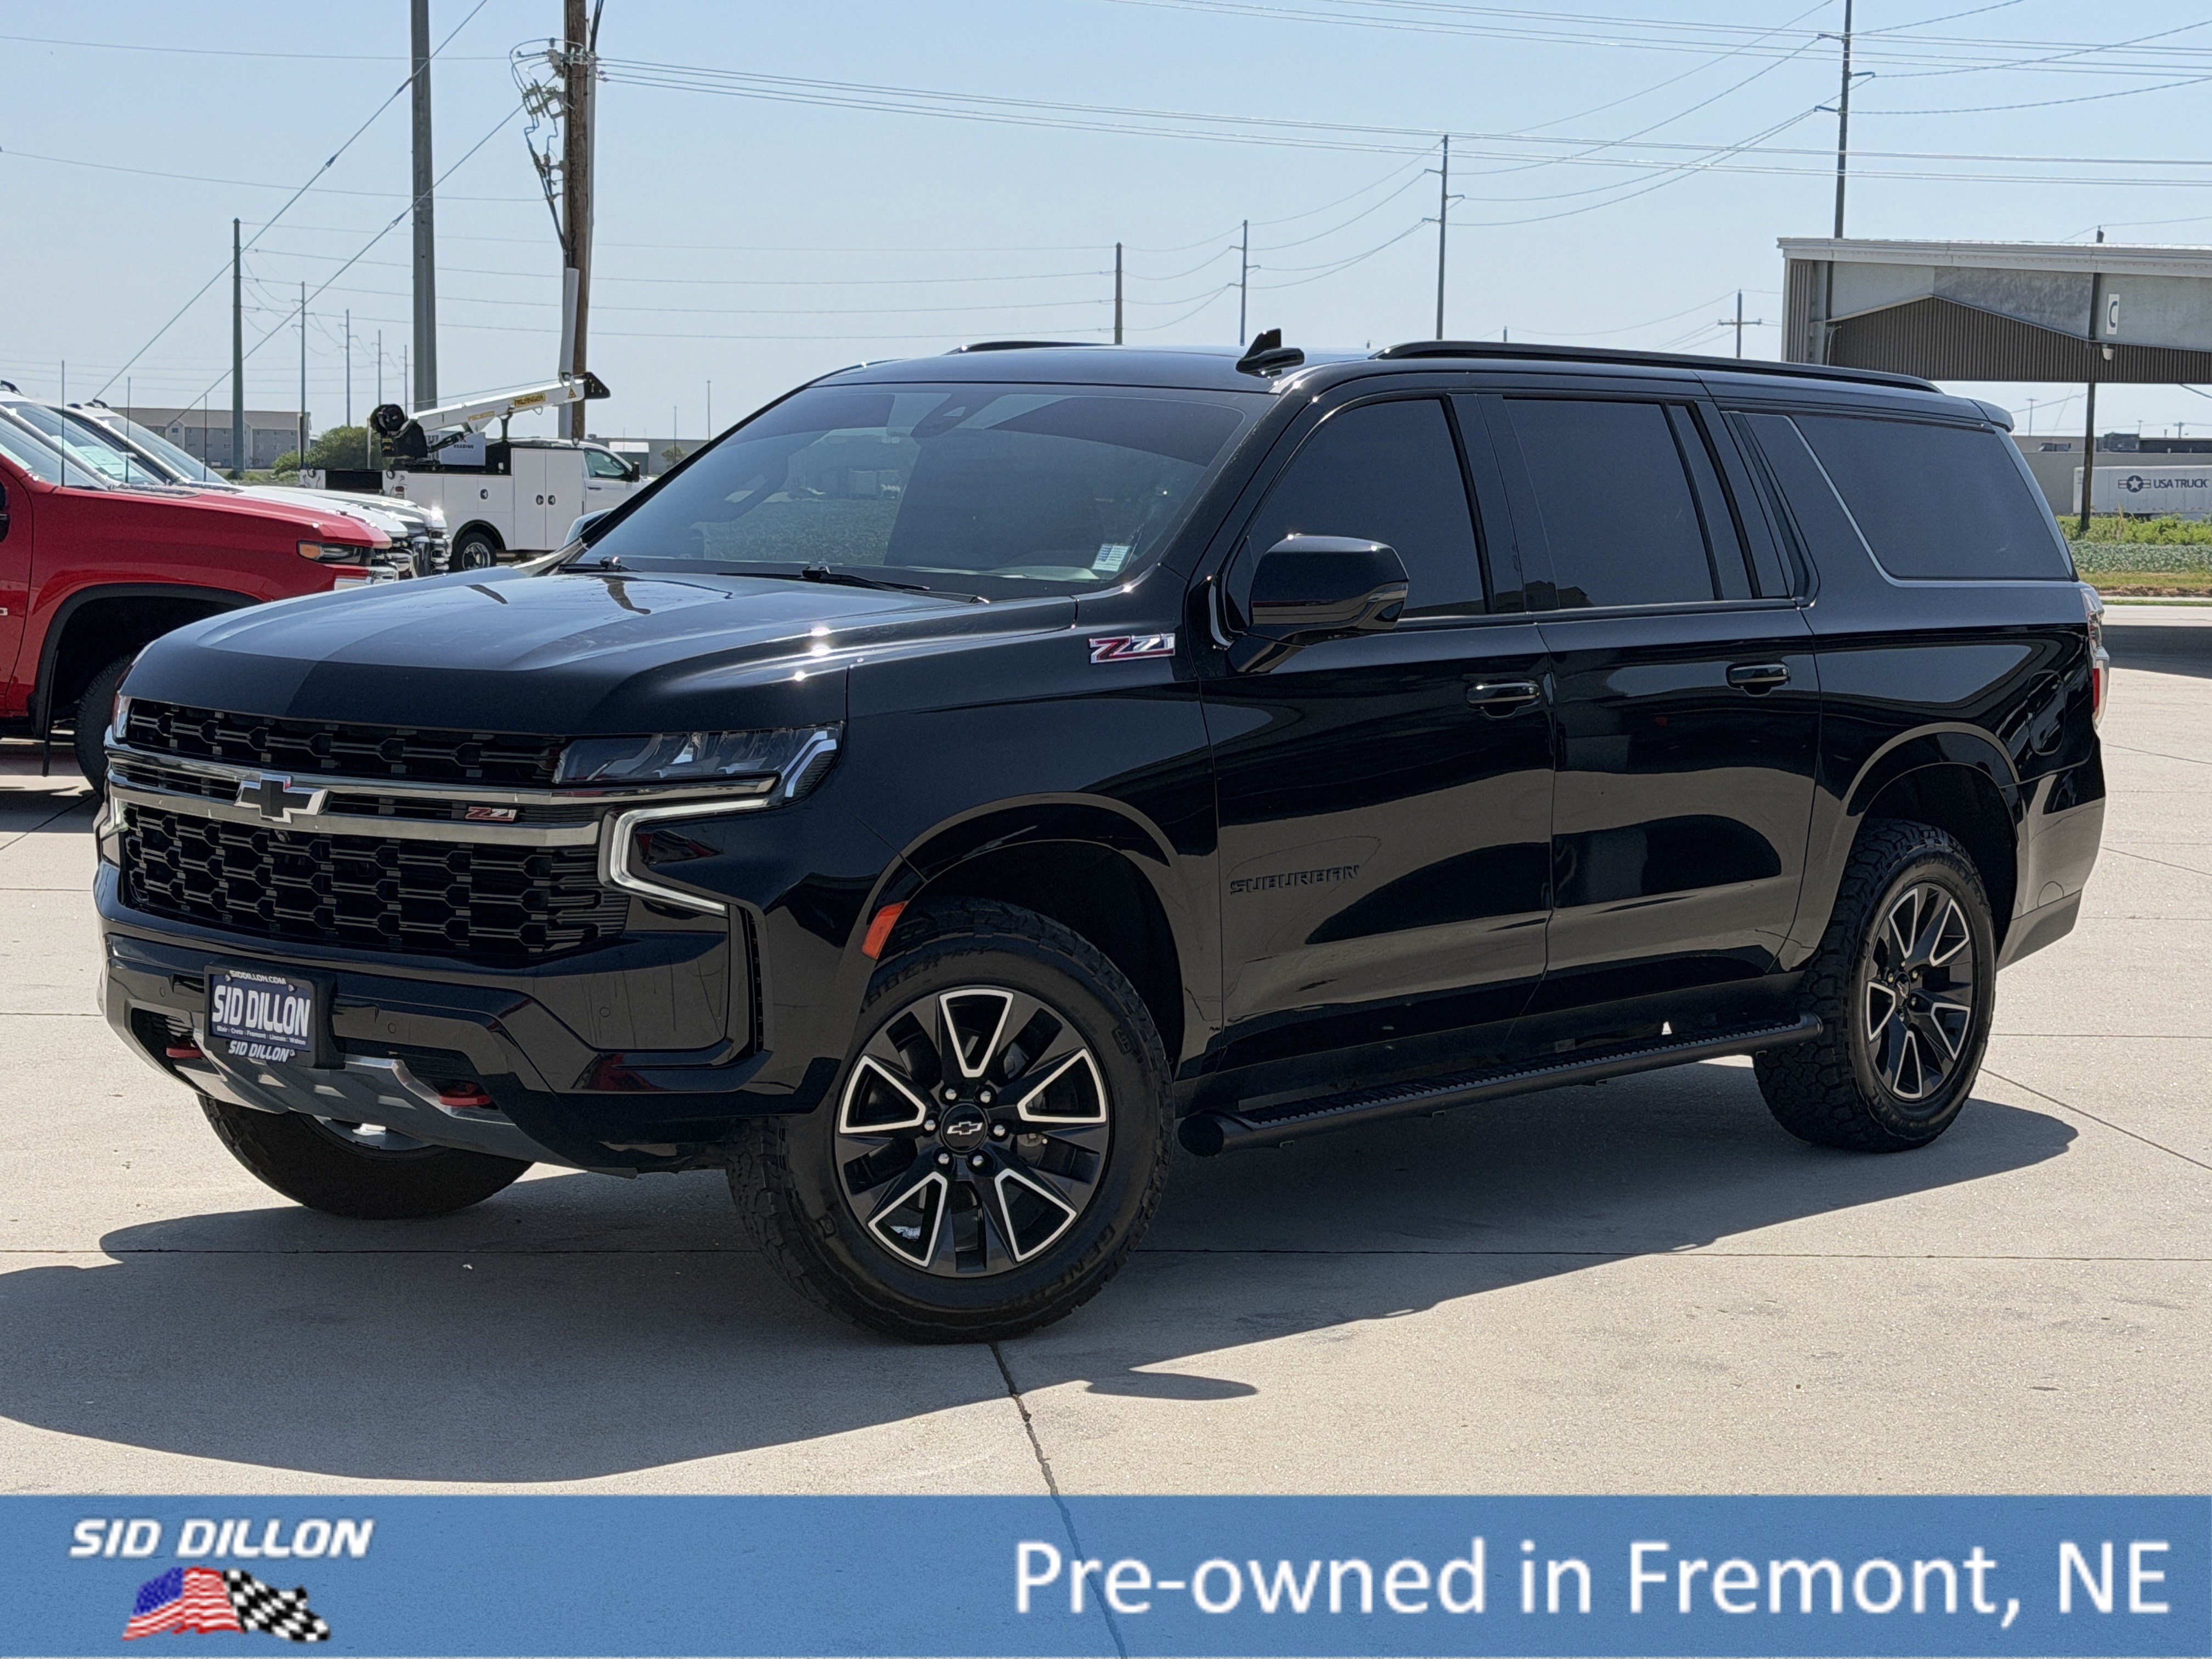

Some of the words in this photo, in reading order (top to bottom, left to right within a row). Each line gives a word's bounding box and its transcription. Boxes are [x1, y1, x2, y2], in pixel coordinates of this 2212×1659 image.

[2109, 300, 2118, 328] C
[2153, 479, 2174, 489] USA
[2175, 478, 2209, 488] TRUCK
[1089, 633, 1176, 664] Z71
[465, 806, 517, 821] Z71
[1231, 865, 1359, 895] SUBURBAN
[229, 970, 286, 985] SIDDILLON.COM
[212, 985, 244, 1025] SID
[245, 990, 311, 1037] DILLON
[228, 1040, 248, 1056] SID
[249, 1044, 290, 1063] DILLON
